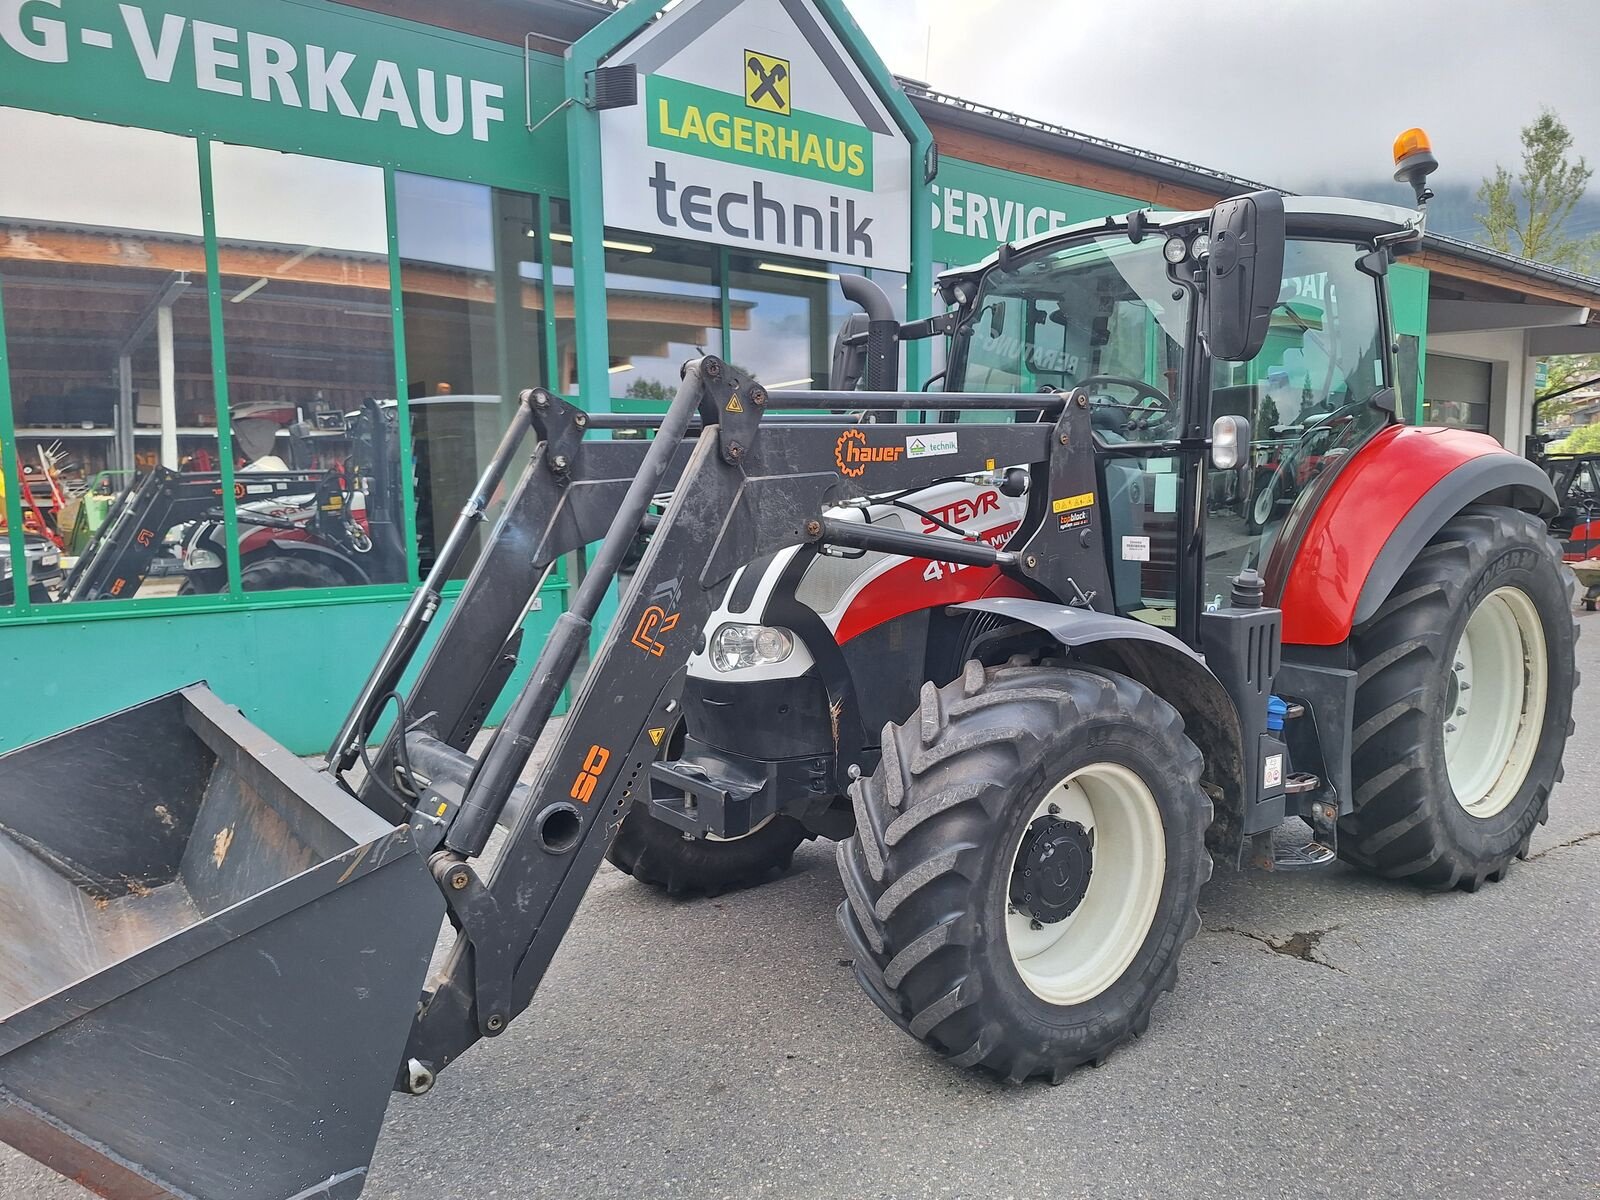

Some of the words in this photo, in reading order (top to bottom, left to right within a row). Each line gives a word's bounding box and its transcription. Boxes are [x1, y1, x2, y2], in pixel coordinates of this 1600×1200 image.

[659, 98, 865, 177] LAGERHAUS
[649, 161, 874, 259] technik
[846, 440, 904, 462] hauer
[921, 490, 1000, 534] STEYR
